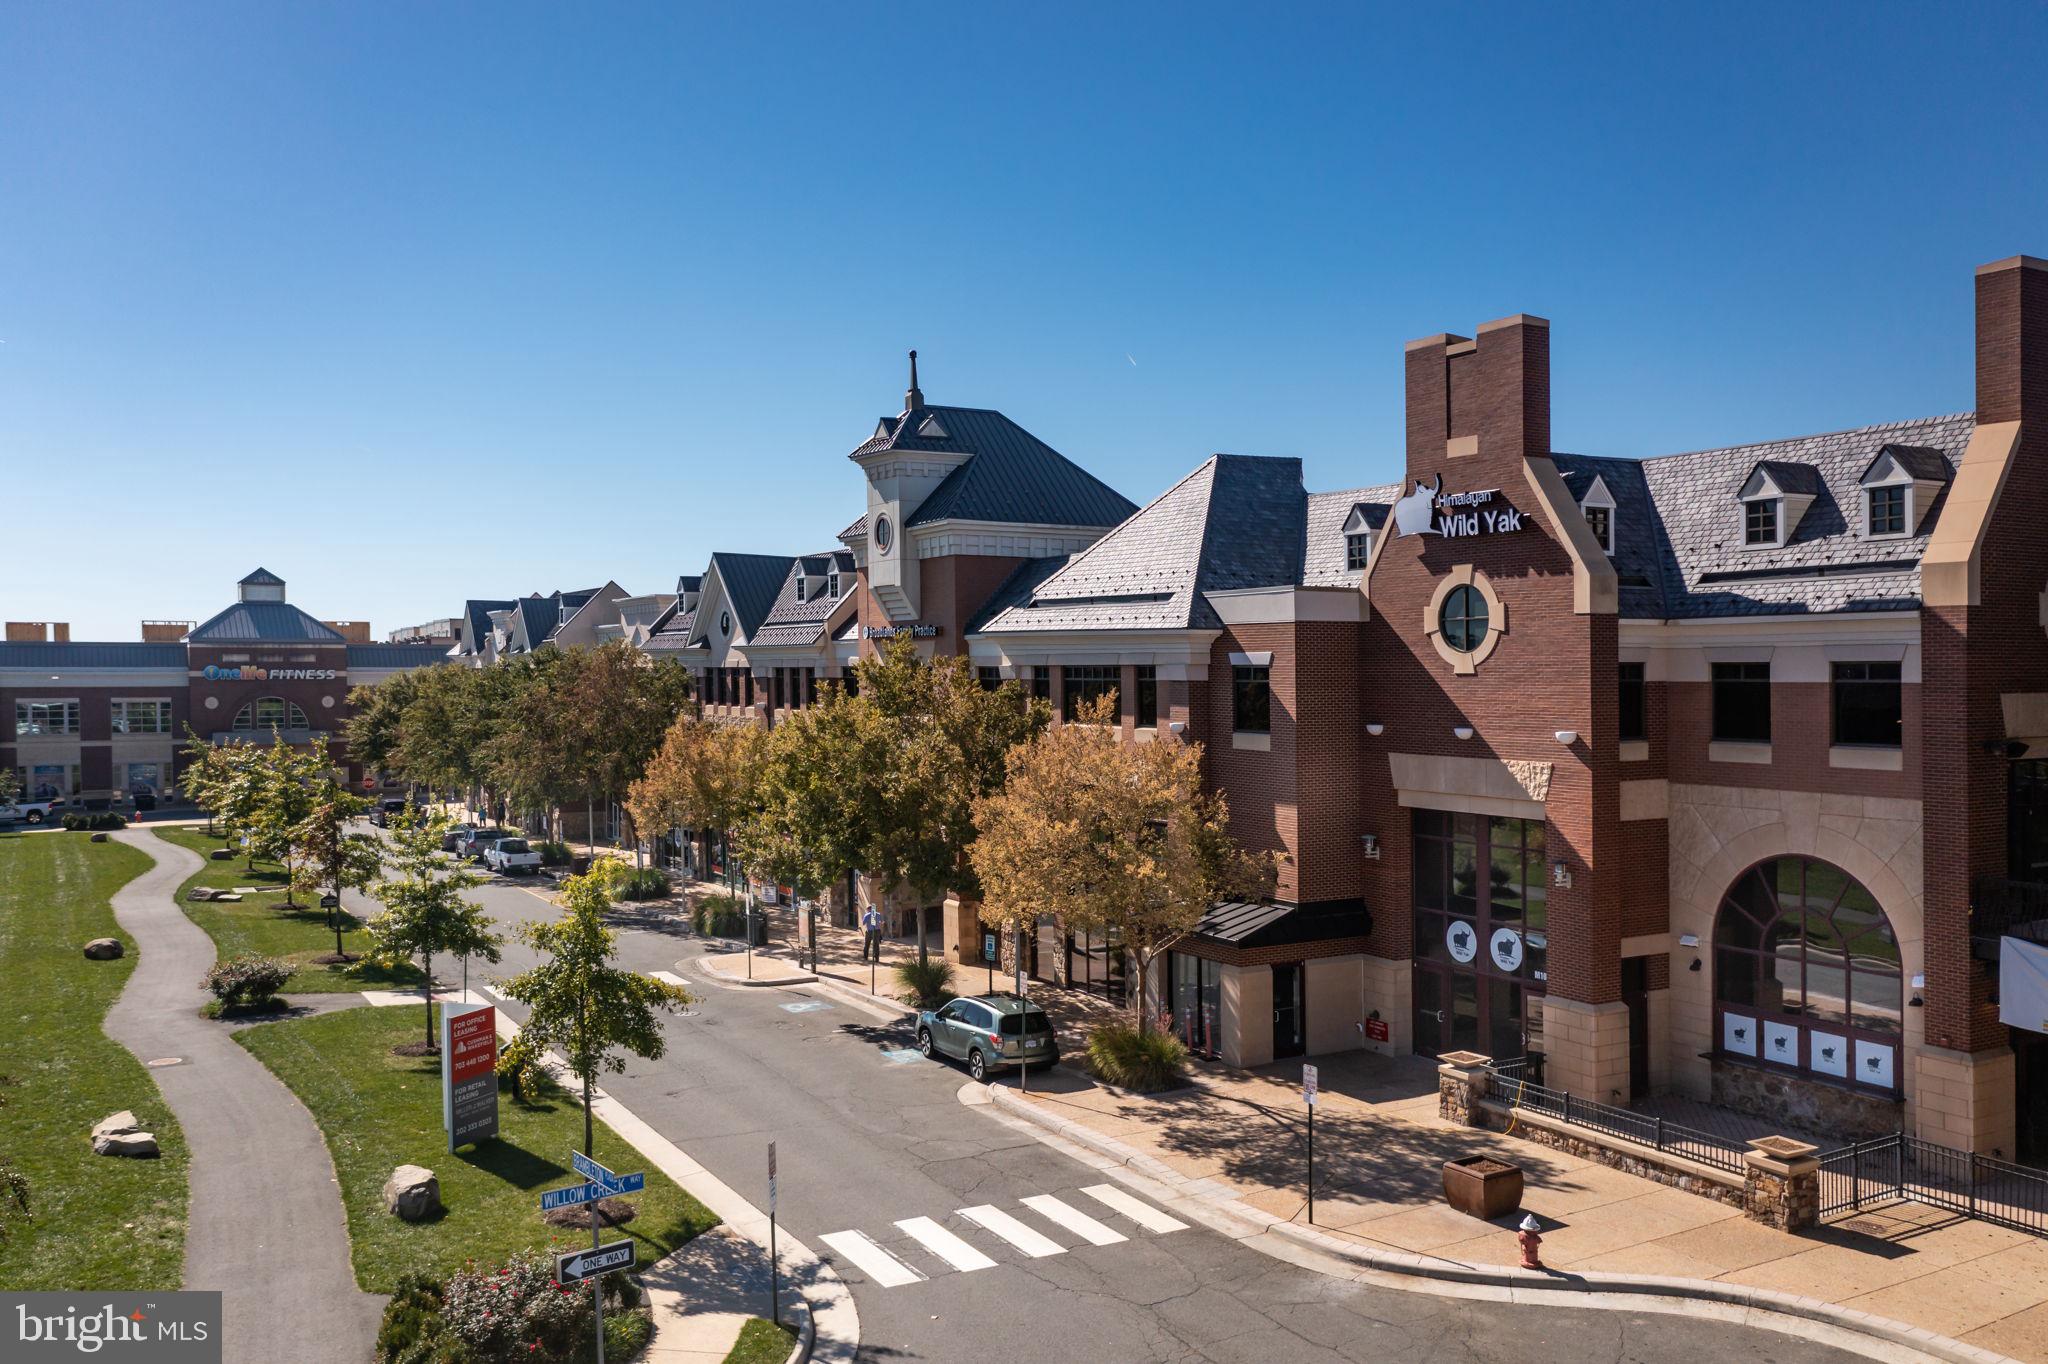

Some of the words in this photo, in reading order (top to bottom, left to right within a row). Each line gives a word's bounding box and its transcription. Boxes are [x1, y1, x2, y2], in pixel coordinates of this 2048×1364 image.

[1438, 491, 1492, 508] Himalayan
[1438, 512, 1479, 538] Wild
[1484, 508, 1522, 533] Yak
[269, 669, 336, 680] FITNESS
[454, 1021, 466, 1031] FOR
[466, 1015, 487, 1025] OFFICE
[454, 1025, 478, 1038] LEASING
[455, 1086, 467, 1096] FOR
[468, 1080, 487, 1091] RETAIL
[455, 1090, 479, 1103] LEASING
[572, 1153, 604, 1182] BRAMBLETON
[544, 1186, 586, 1208] WILLOW
[630, 1174, 641, 1184] WAY
[582, 1256, 602, 1270] ONE
[606, 1249, 627, 1263] WAY
